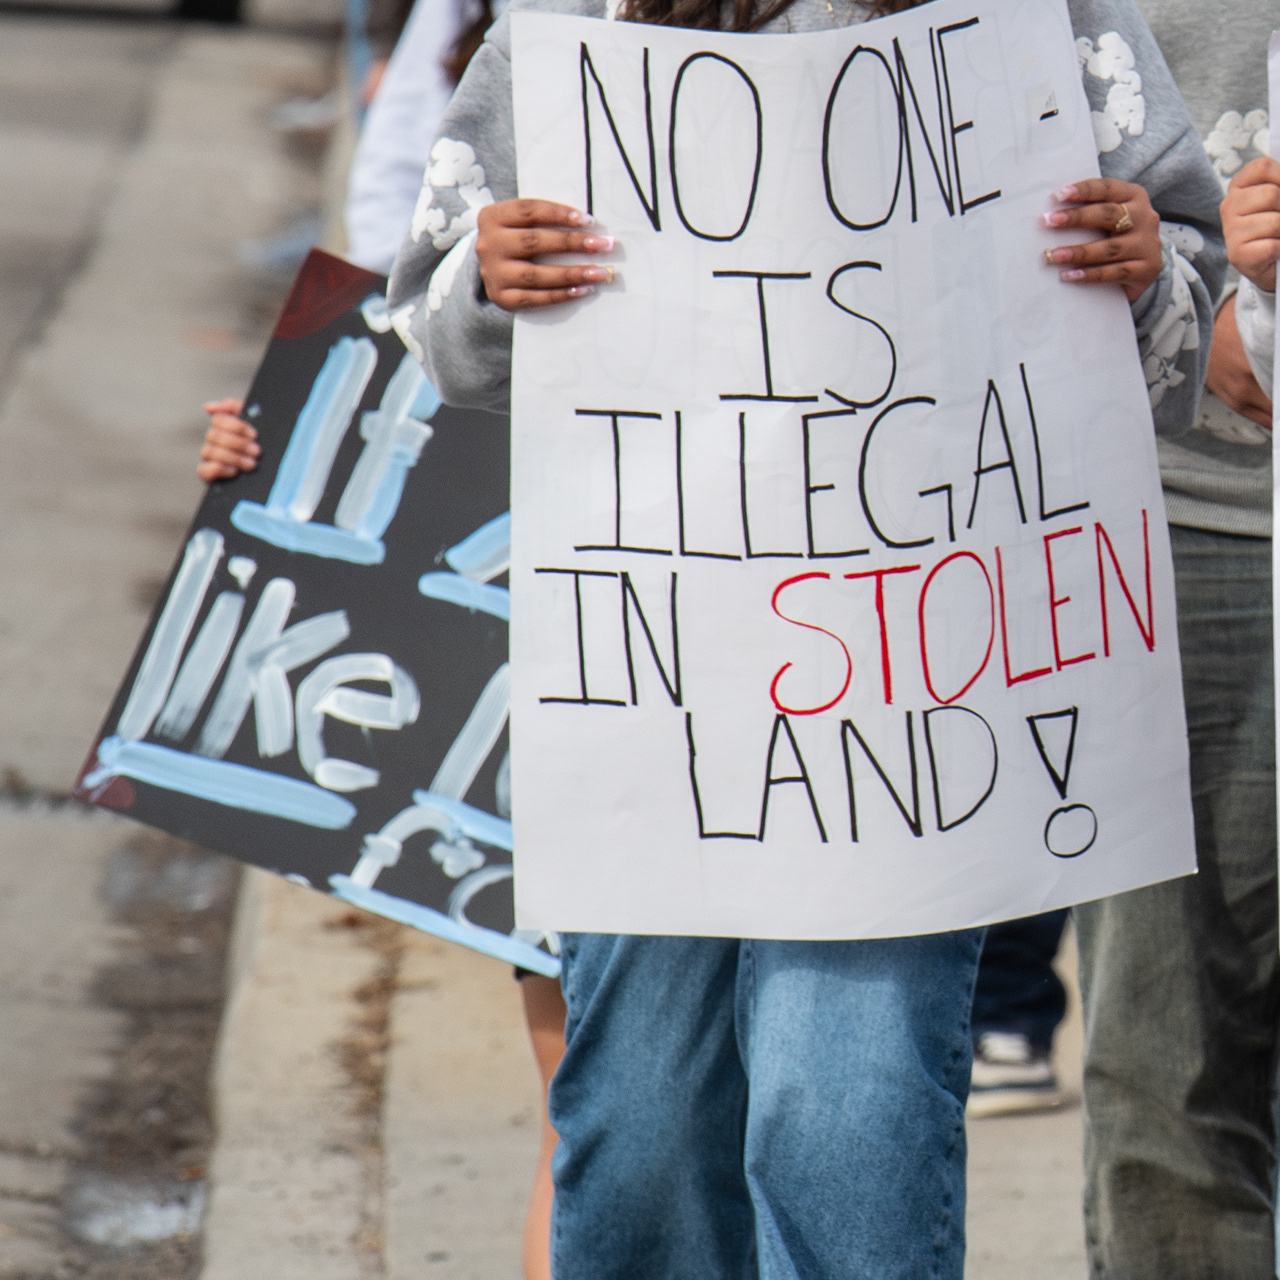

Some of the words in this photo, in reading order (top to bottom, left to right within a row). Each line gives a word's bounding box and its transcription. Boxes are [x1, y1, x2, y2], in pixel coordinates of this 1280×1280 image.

[580, 41, 763, 242] NO
[822, 16, 1002, 231] ONE
[712, 260, 897, 408] IS
[573, 362, 1090, 561] ILLEGAL
[115, 527, 421, 792] like
[534, 568, 682, 708] IN
[769, 508, 1156, 716] STOLEN
